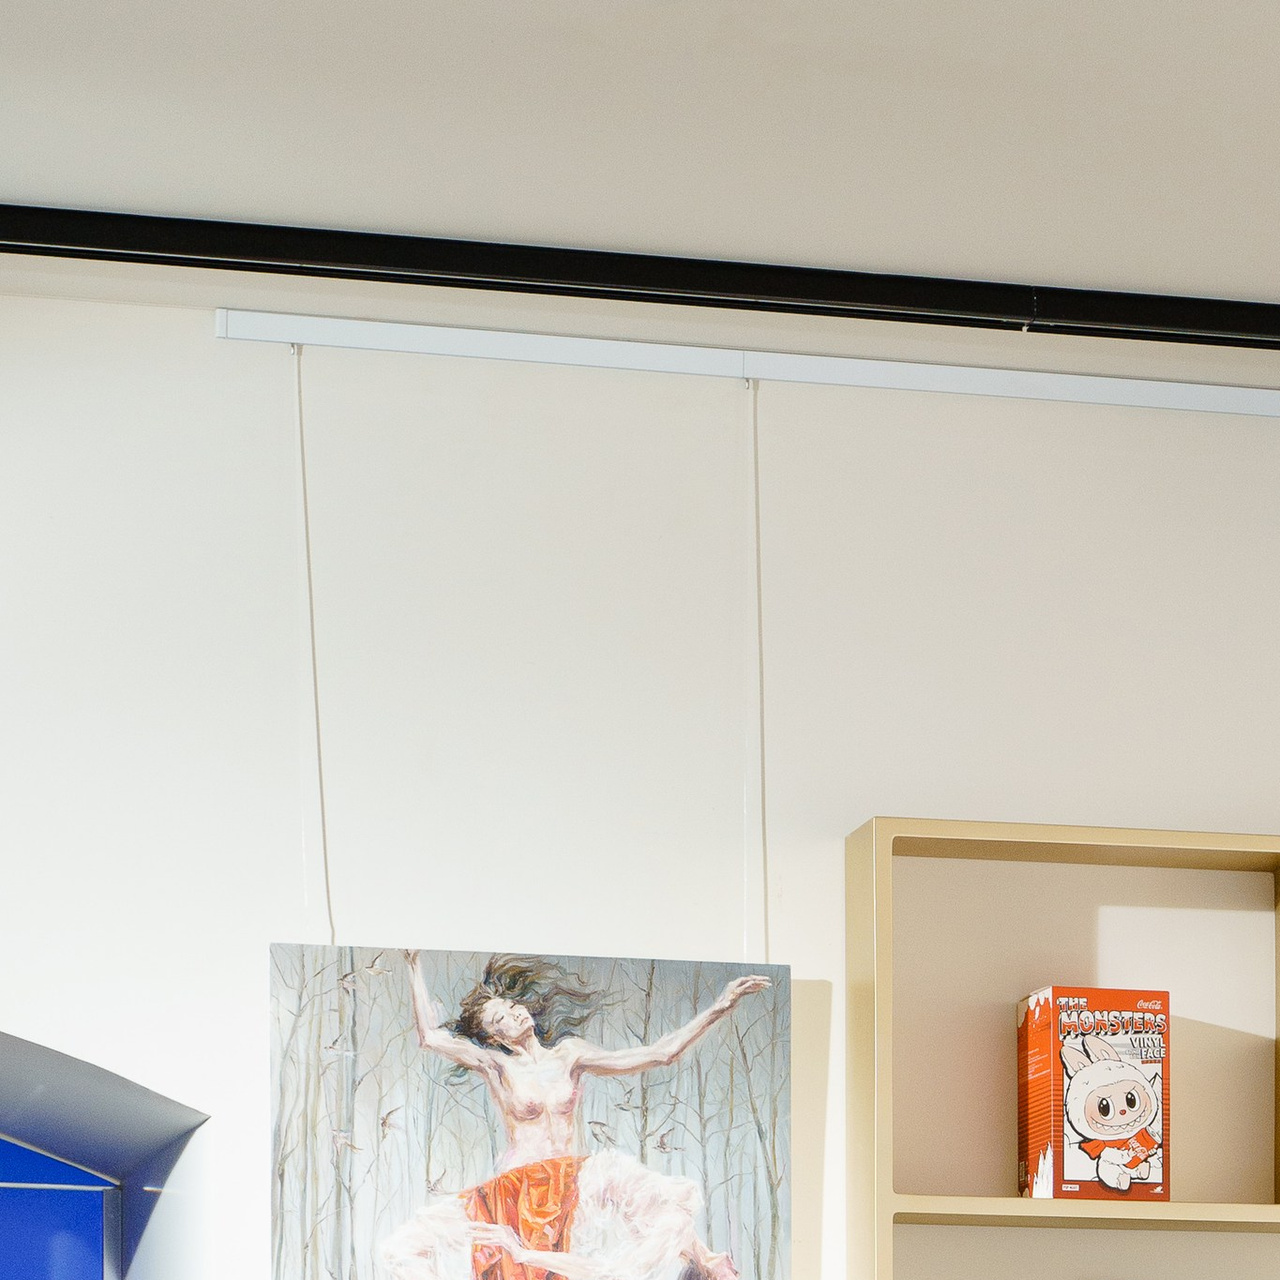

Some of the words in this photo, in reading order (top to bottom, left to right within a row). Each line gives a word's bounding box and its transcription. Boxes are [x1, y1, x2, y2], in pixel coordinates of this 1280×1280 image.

[1057, 997, 1088, 1011] THE
[1060, 1010, 1168, 1036] MONSTERS
[1130, 1036, 1166, 1048] VINYL
[1140, 1048, 1166, 1058] FACE
